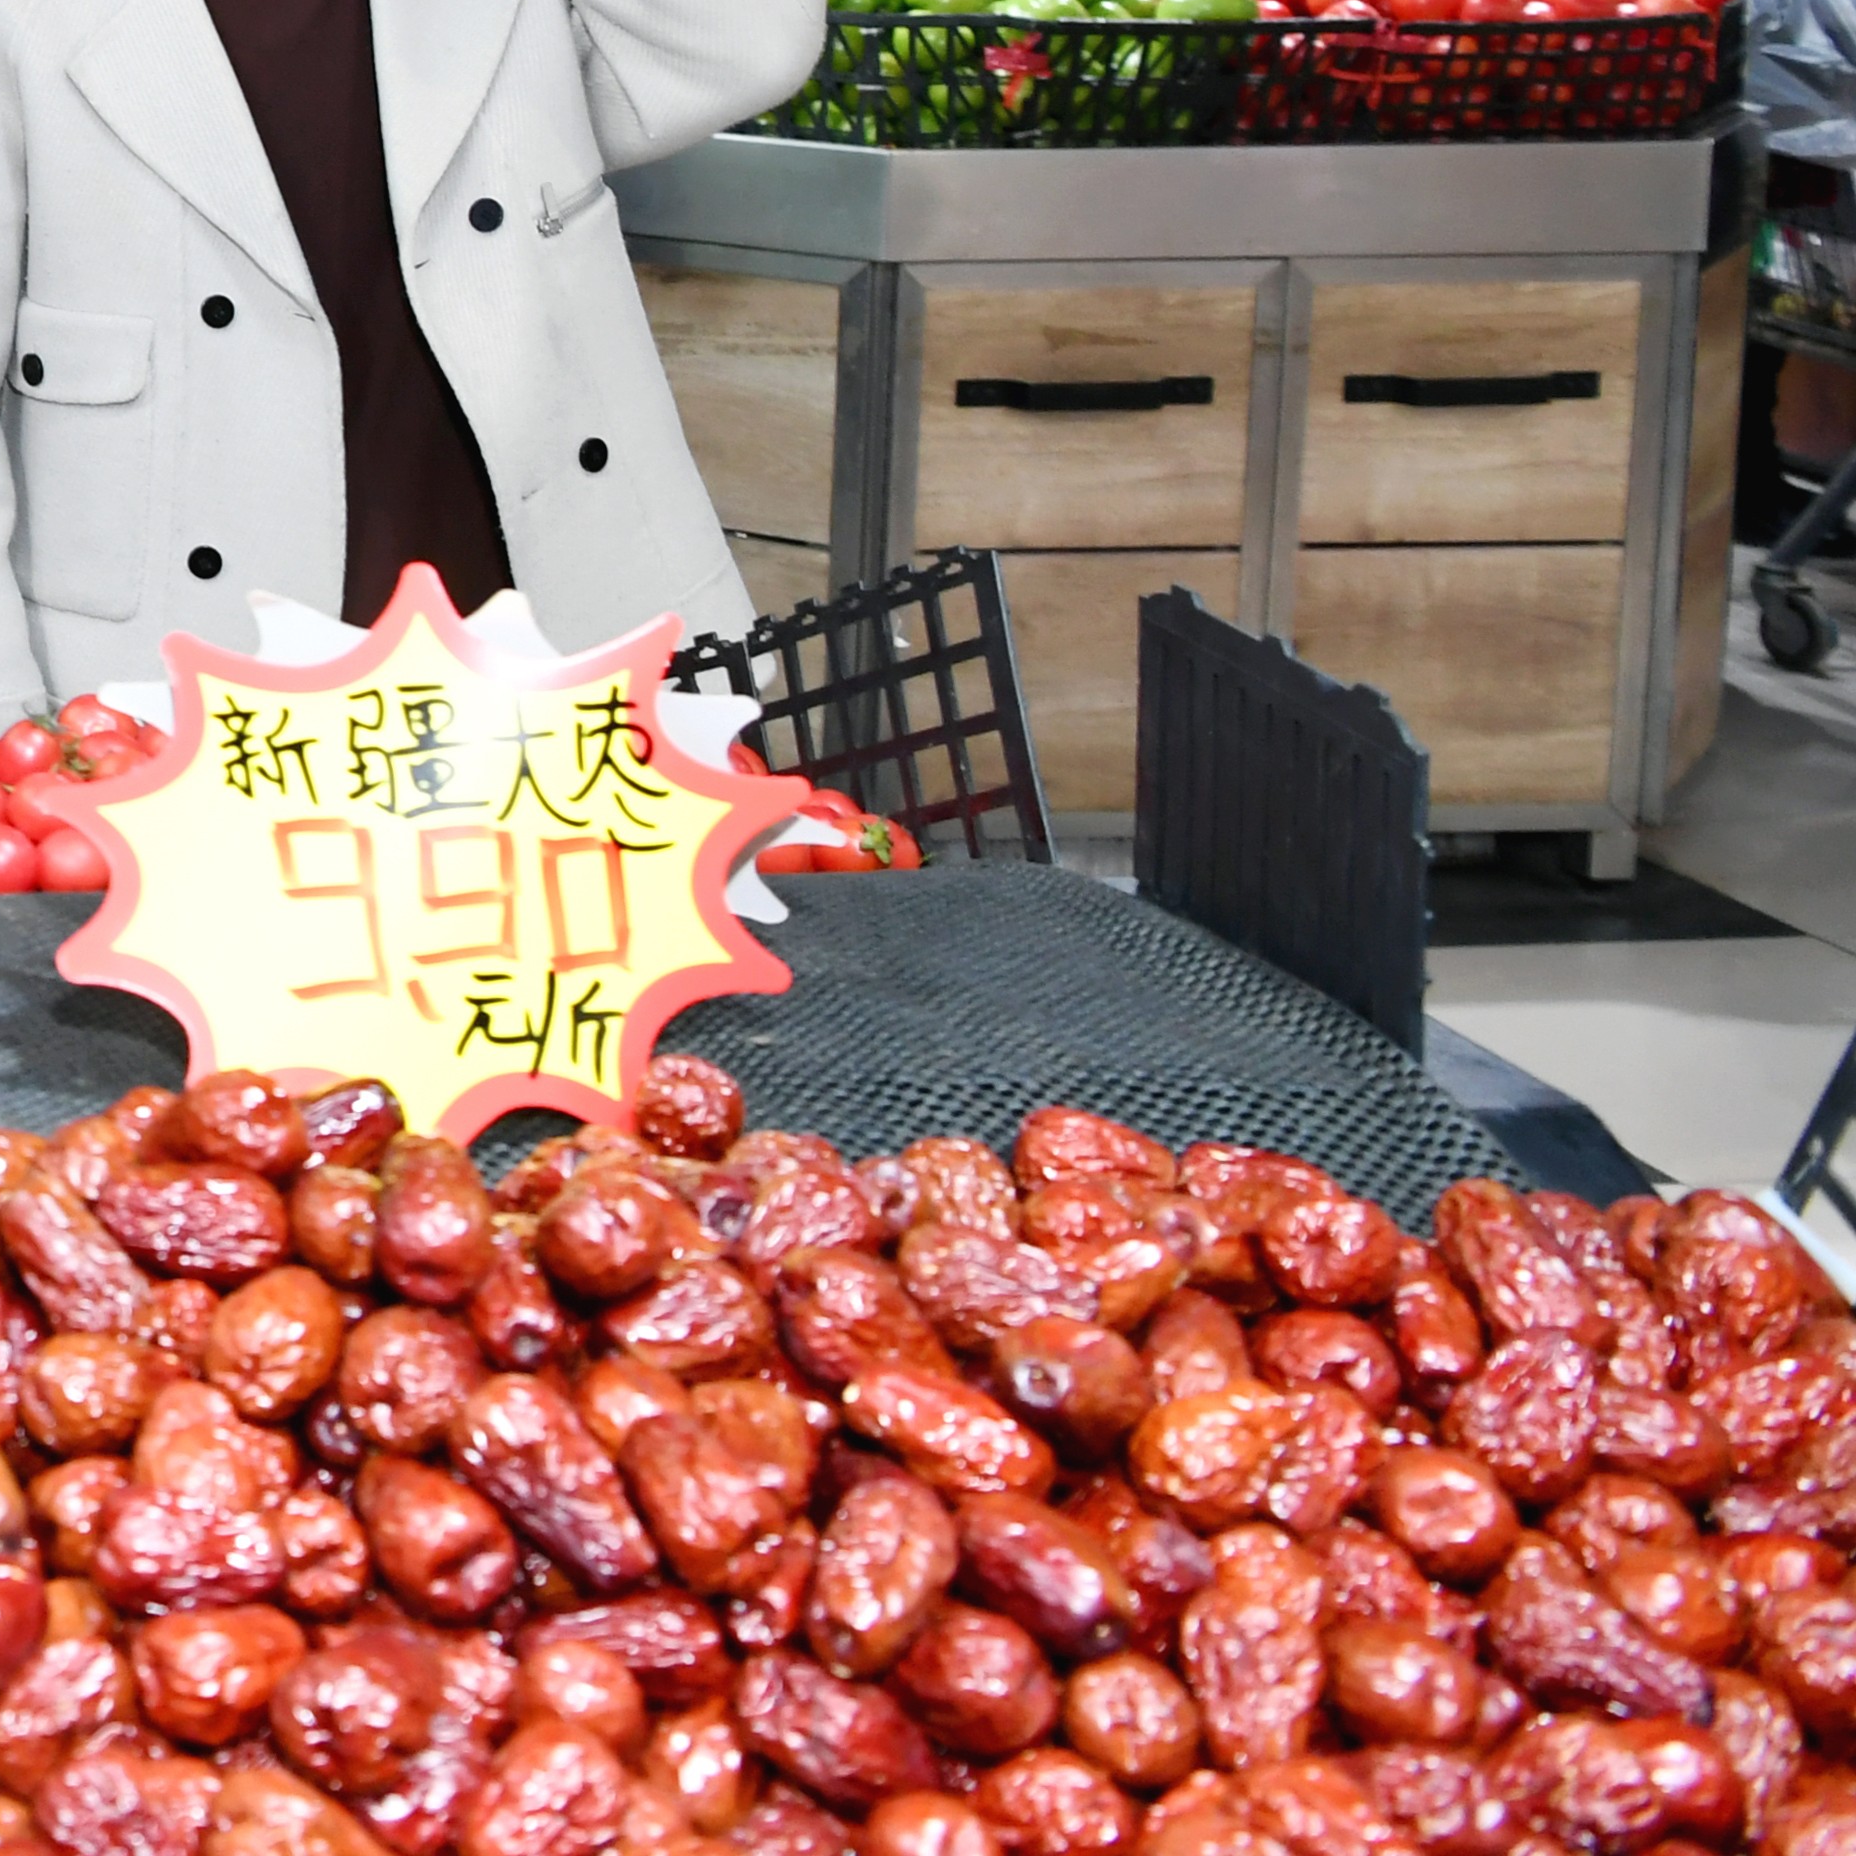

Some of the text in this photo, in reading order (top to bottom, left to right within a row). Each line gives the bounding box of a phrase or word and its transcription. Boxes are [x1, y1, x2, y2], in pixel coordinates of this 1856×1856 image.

[210, 685, 674, 850] 新疆大枣
[274, 818, 630, 1021] 9.90
